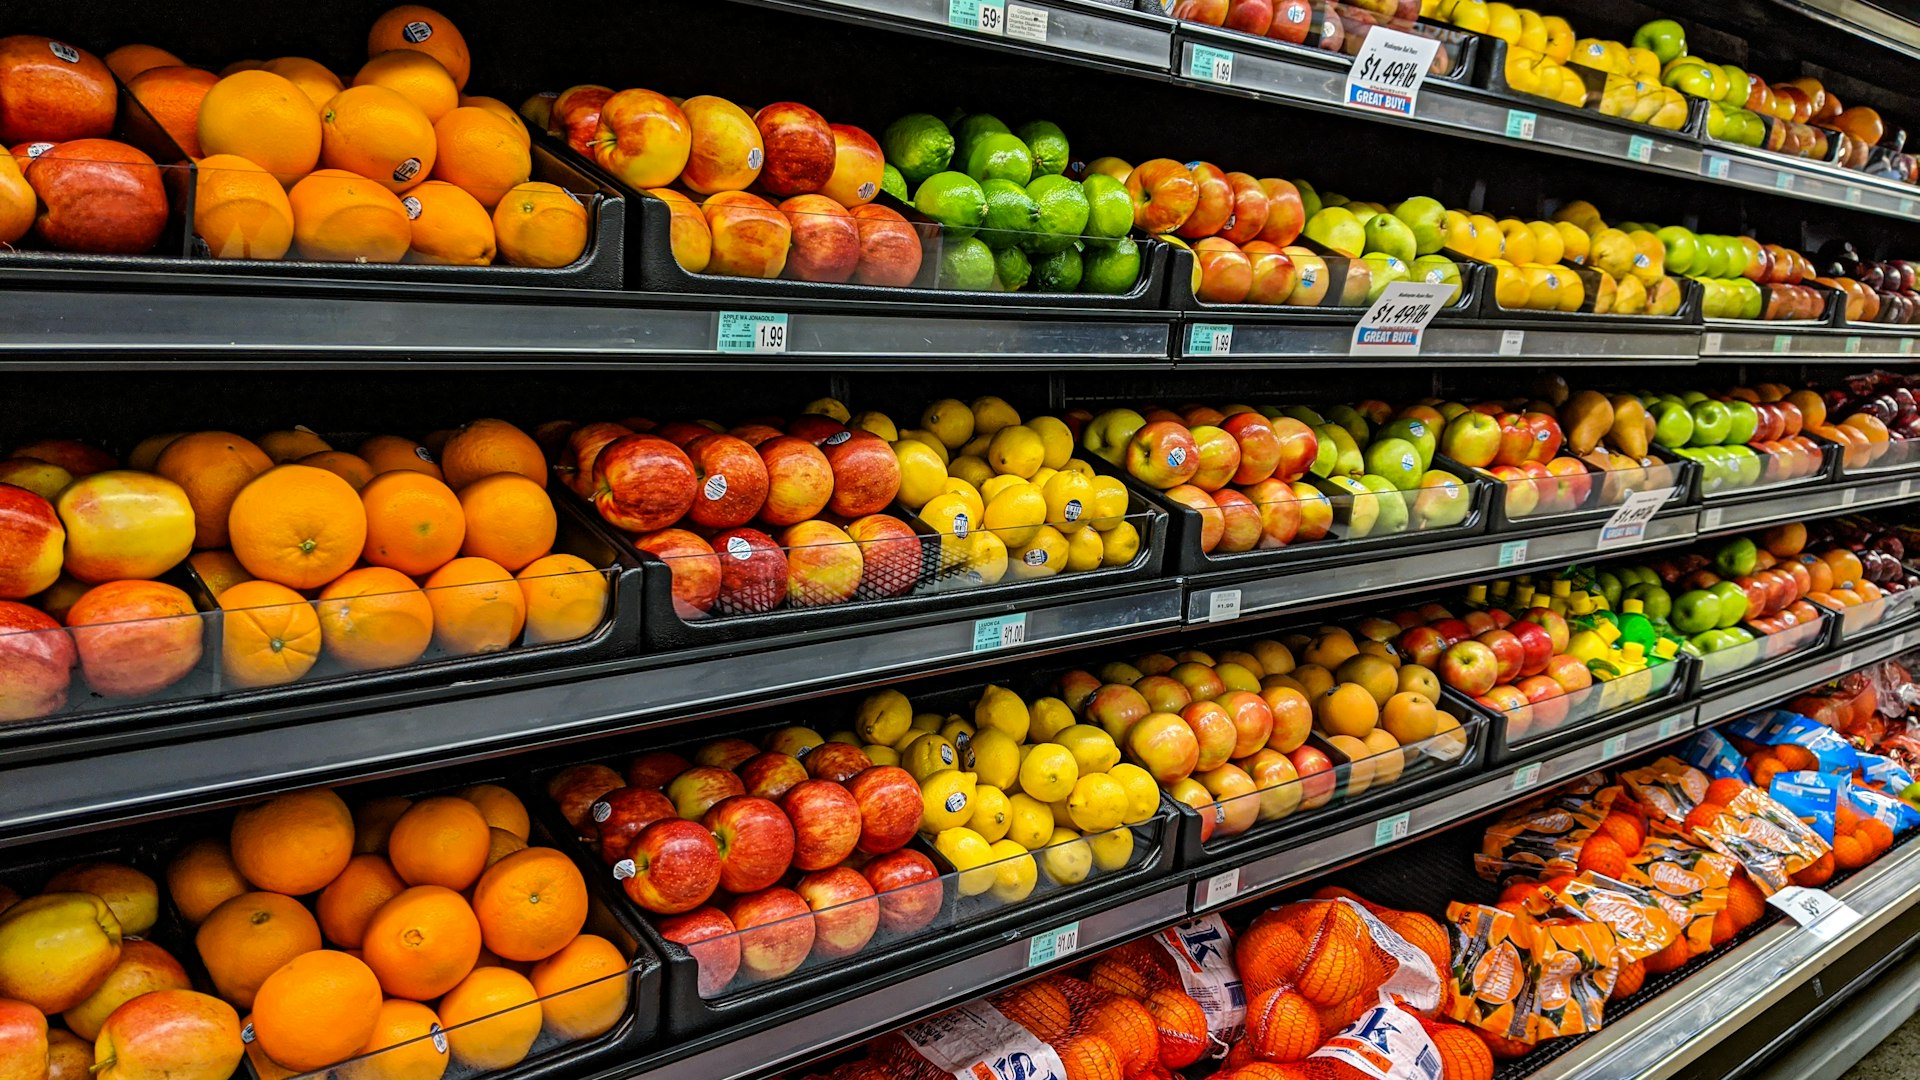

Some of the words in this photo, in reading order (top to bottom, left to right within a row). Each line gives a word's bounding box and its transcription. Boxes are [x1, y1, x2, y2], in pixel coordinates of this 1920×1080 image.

[1216, 61, 1230, 80] 1.99
[1360, 53, 1404, 85] $1.49
[1356, 89, 1384, 108] GREAT
[1385, 94, 1406, 111] BUY!
[761, 325, 783, 347] 1.99
[1215, 334, 1230, 351] 1.99
[1363, 330, 1392, 343] GREAT
[1392, 331, 1413, 343] BUY!
